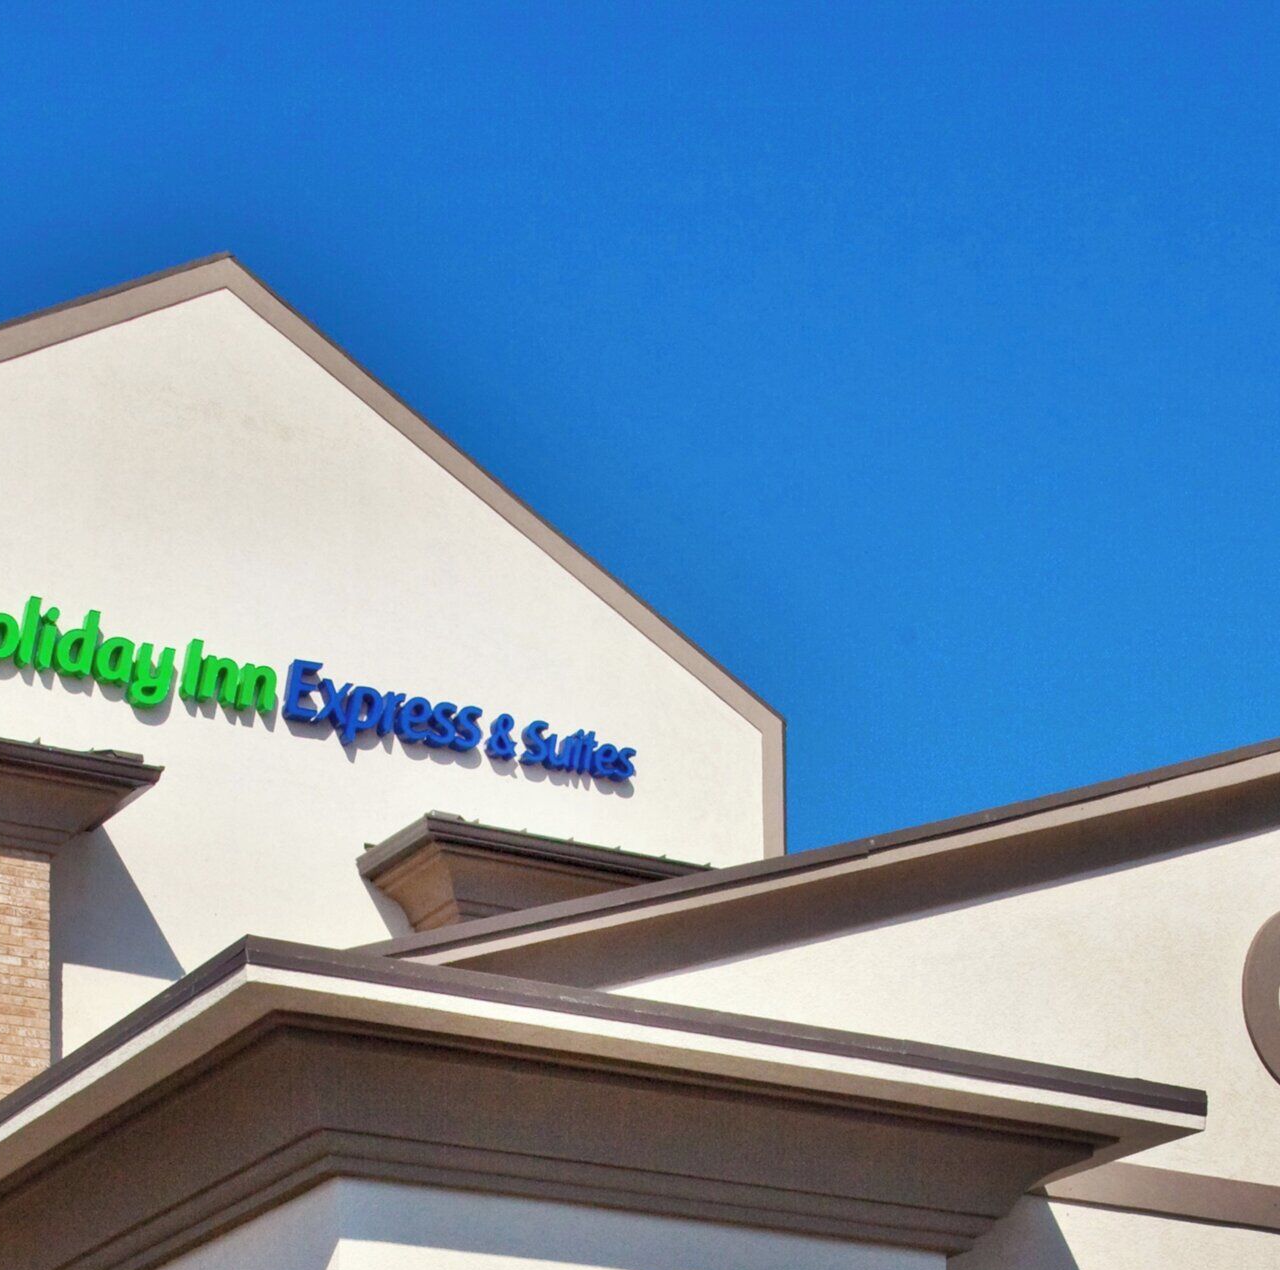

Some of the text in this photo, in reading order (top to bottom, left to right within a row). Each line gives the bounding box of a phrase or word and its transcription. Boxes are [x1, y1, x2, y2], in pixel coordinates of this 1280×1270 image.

[179, 638, 277, 714] Inn
[282, 659, 483, 752] Express
[485, 713, 517, 761] &
[520, 720, 637, 782] Suites
